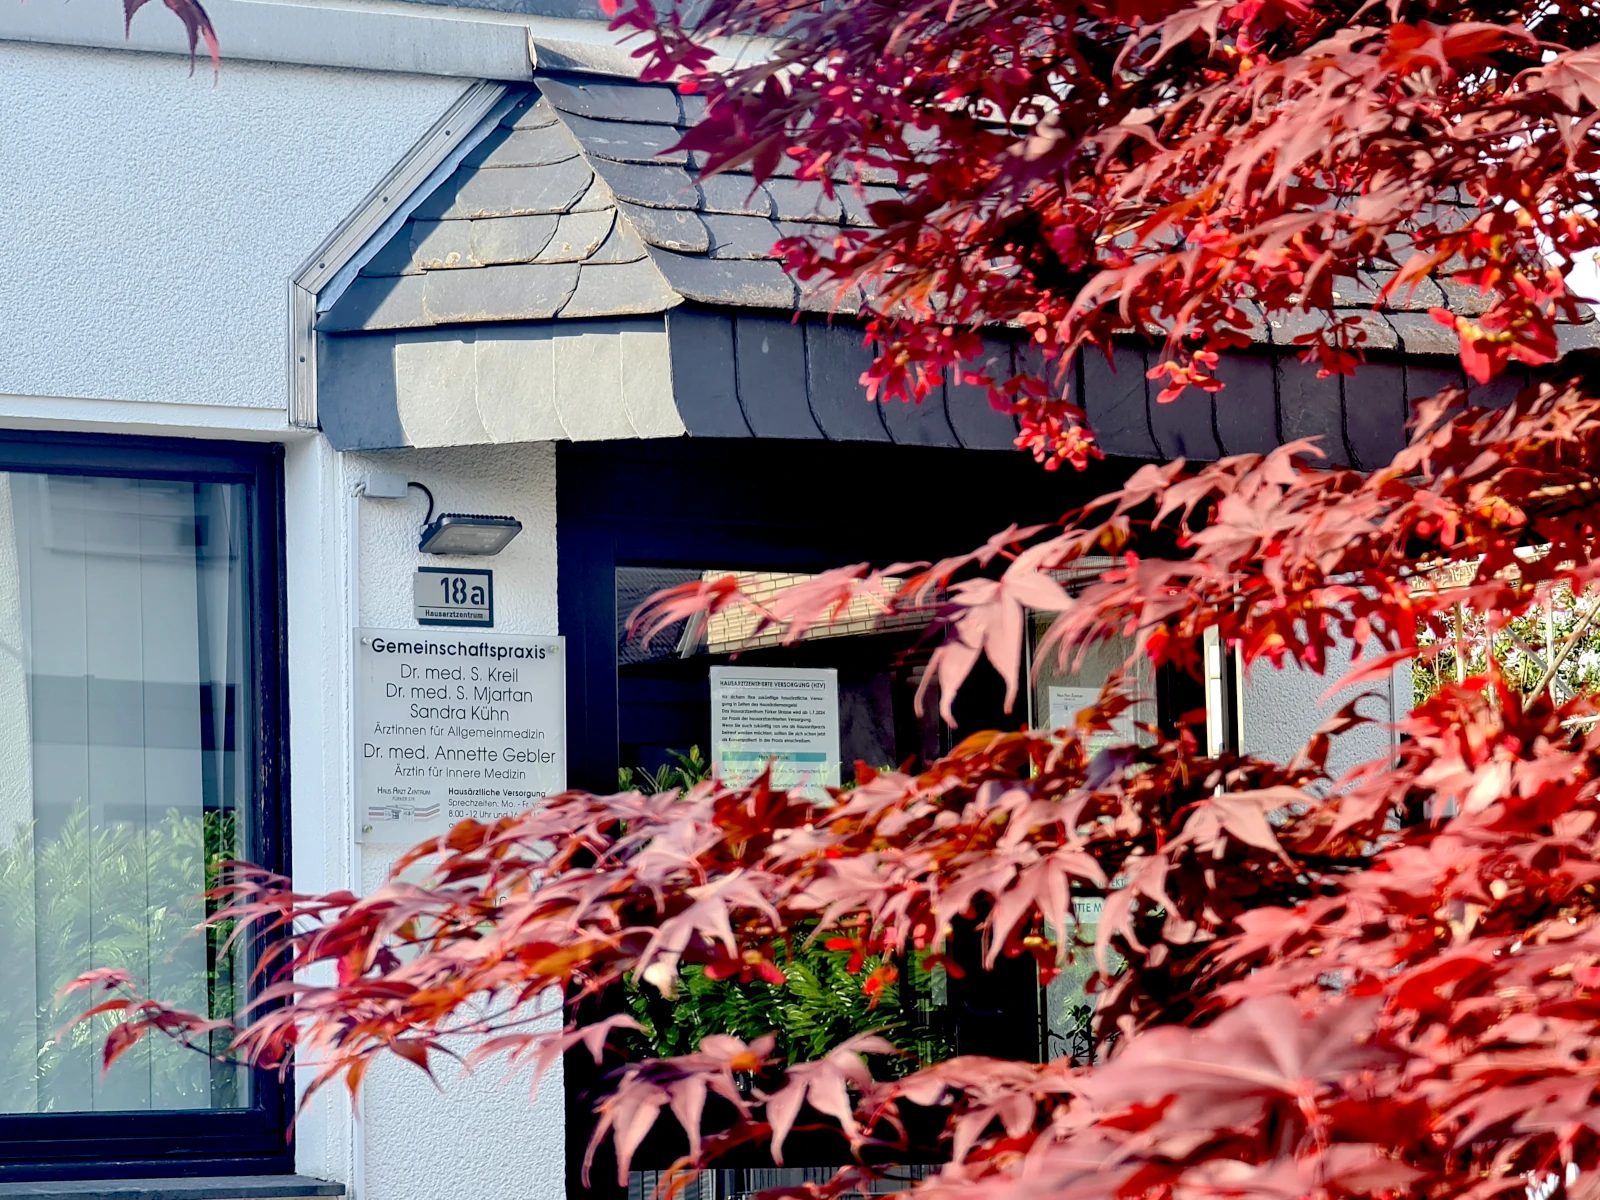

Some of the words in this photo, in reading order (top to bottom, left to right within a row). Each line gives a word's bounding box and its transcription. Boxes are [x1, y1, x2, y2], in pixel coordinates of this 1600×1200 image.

[440, 577, 485, 606] 18a
[425, 609, 484, 620] Hausarztzentrum
[371, 637, 547, 661] Gemeinschaftspraxis
[400, 663, 419, 680] Dr.
[425, 665, 465, 681] med.
[471, 666, 482, 682] S.
[488, 667, 519, 683] Kreil
[386, 682, 405, 699] Dr.
[411, 684, 451, 700] med.
[456, 685, 468, 701] S.
[474, 686, 533, 705] Mjartan
[410, 703, 466, 720] Sandra
[471, 704, 510, 722] Kühn
[374, 722, 426, 736] Ärztinnen
[430, 725, 444, 737] für
[448, 725, 545, 741] Allgemeinmedizin
[364, 743, 383, 759] Dr.
[389, 744, 429, 760] med.
[435, 745, 498, 763] Annette
[502, 746, 556, 764] Gebler
[394, 763, 425, 778] Ärztin
[428, 765, 442, 778] für
[446, 766, 481, 779] Innere
[484, 767, 526, 780] Medizin
[448, 787, 501, 797] Hausärztliche
[503, 788, 547, 799] Versorgung
[448, 798, 499, 808] Sprechzeiten:
[502, 800, 515, 808] Mo.
[448, 810, 464, 818] 8.00
[470, 811, 478, 819] 12
[494, 811, 508, 819] und
